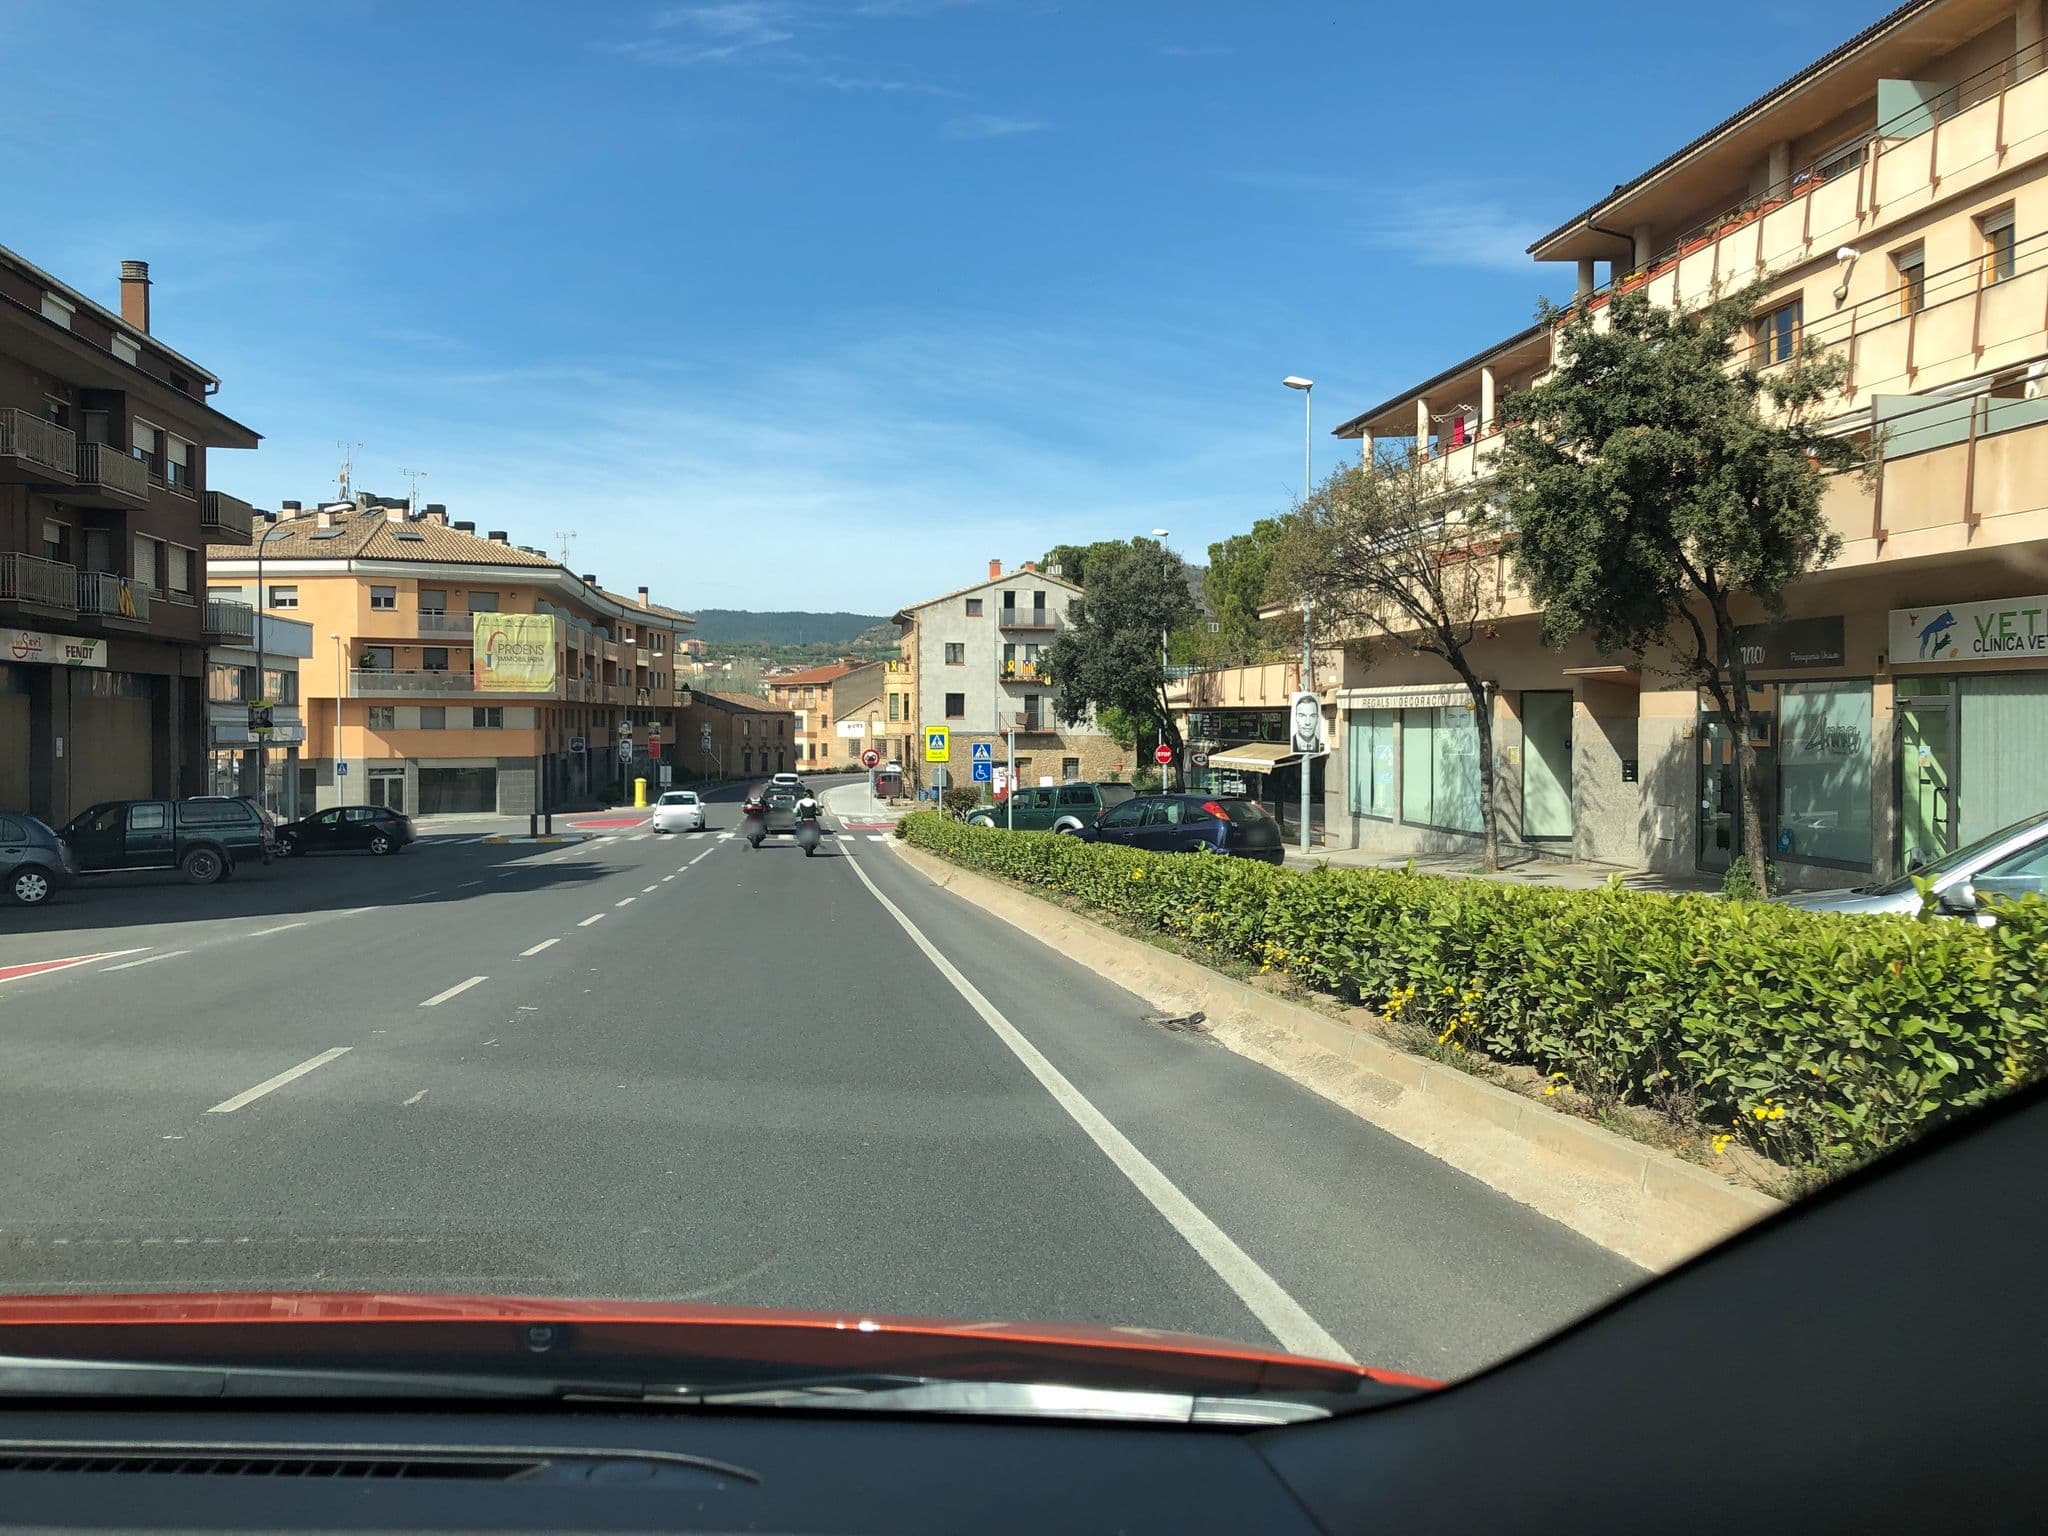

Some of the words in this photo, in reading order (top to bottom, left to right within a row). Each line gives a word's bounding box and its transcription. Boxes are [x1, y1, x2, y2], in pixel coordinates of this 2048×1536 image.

[1974, 609, 2048, 639] VET
[497, 644, 544, 656] PROENS
[1973, 634, 2025, 653] CLÍNICA
[2027, 634, 2048, 650] VE
[65, 645, 94, 660] FENDT
[1362, 697, 1390, 708] REGALS
[1805, 710, 1862, 754] Anna
